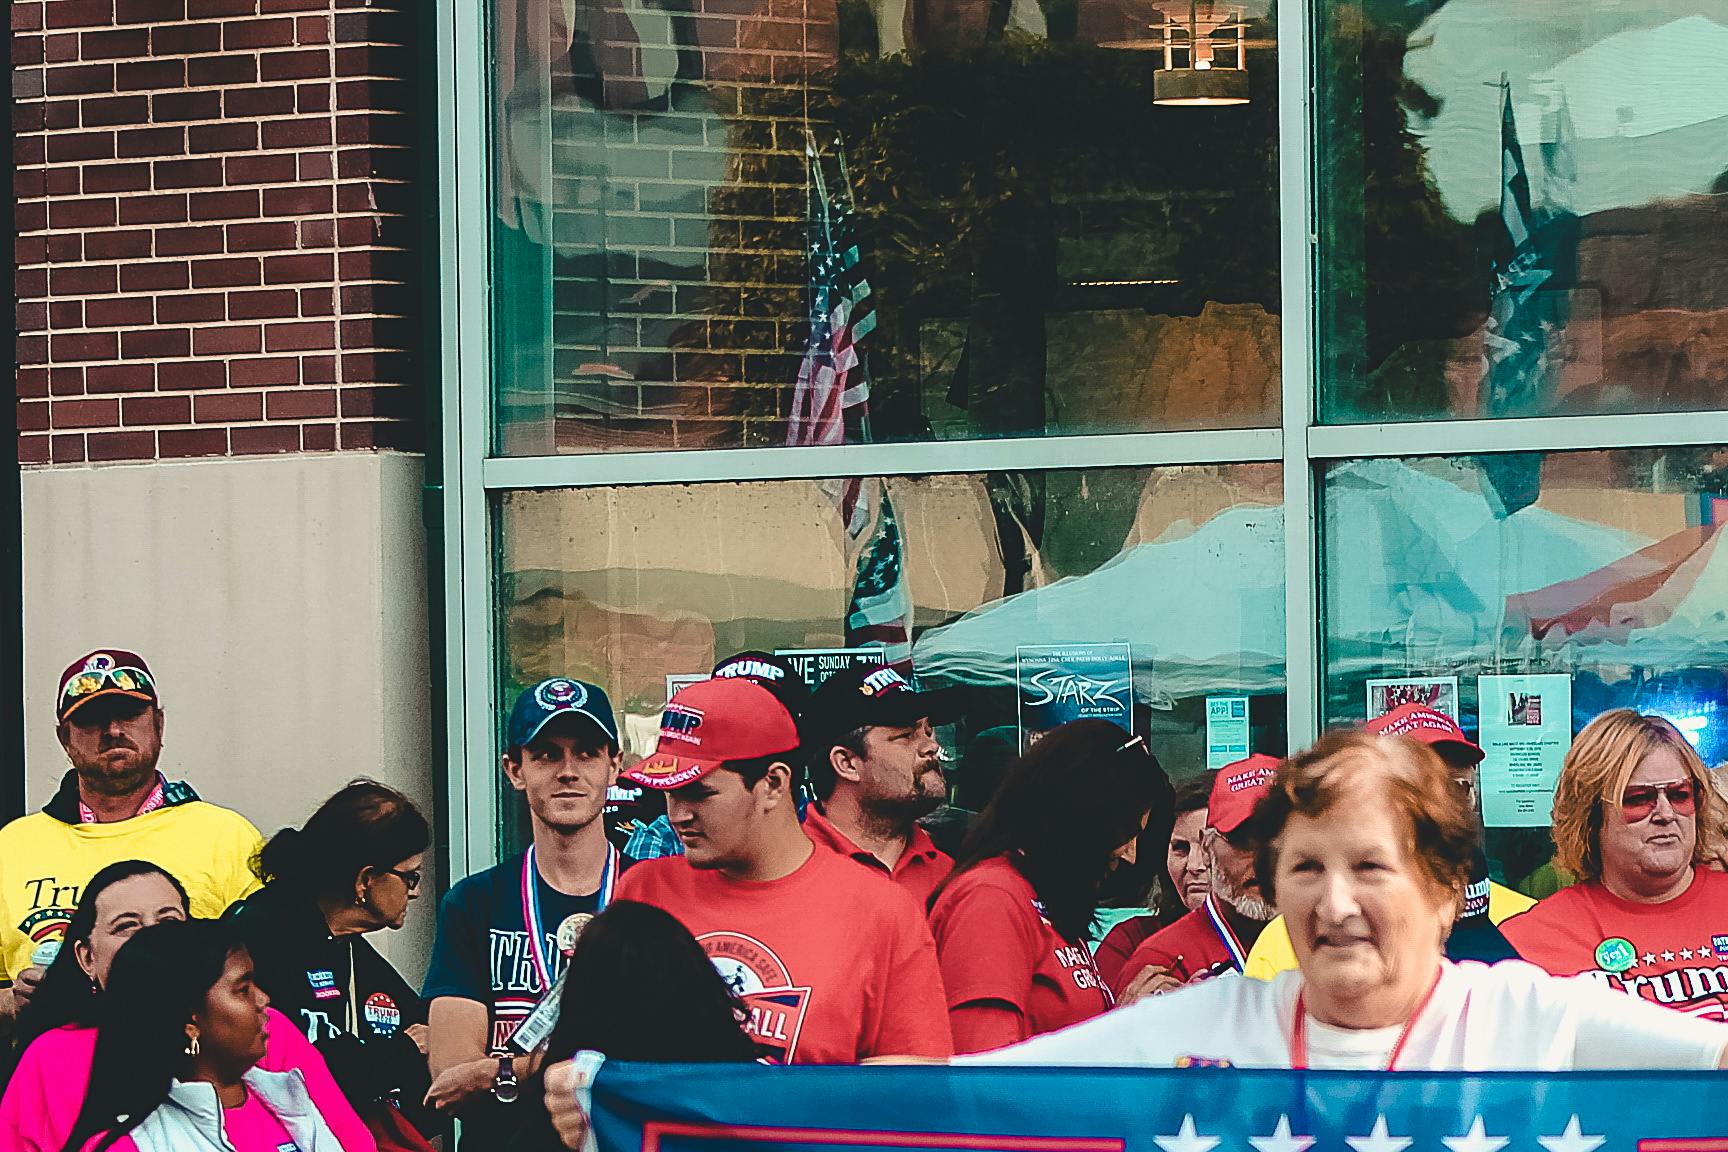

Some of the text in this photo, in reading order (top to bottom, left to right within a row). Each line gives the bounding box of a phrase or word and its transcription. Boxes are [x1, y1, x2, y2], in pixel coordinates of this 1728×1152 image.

[715, 660, 784, 681] TRUMP
[819, 656, 850, 670] SUNDAY
[1025, 669, 1126, 710] STARZ
[1379, 716, 1408, 737] MAKE
[652, 765, 701, 787] PRESIDENT
[1227, 769, 1256, 785] MAKE
[1230, 777, 1264, 792] GREAT
[368, 1006, 400, 1018] TRUMP
